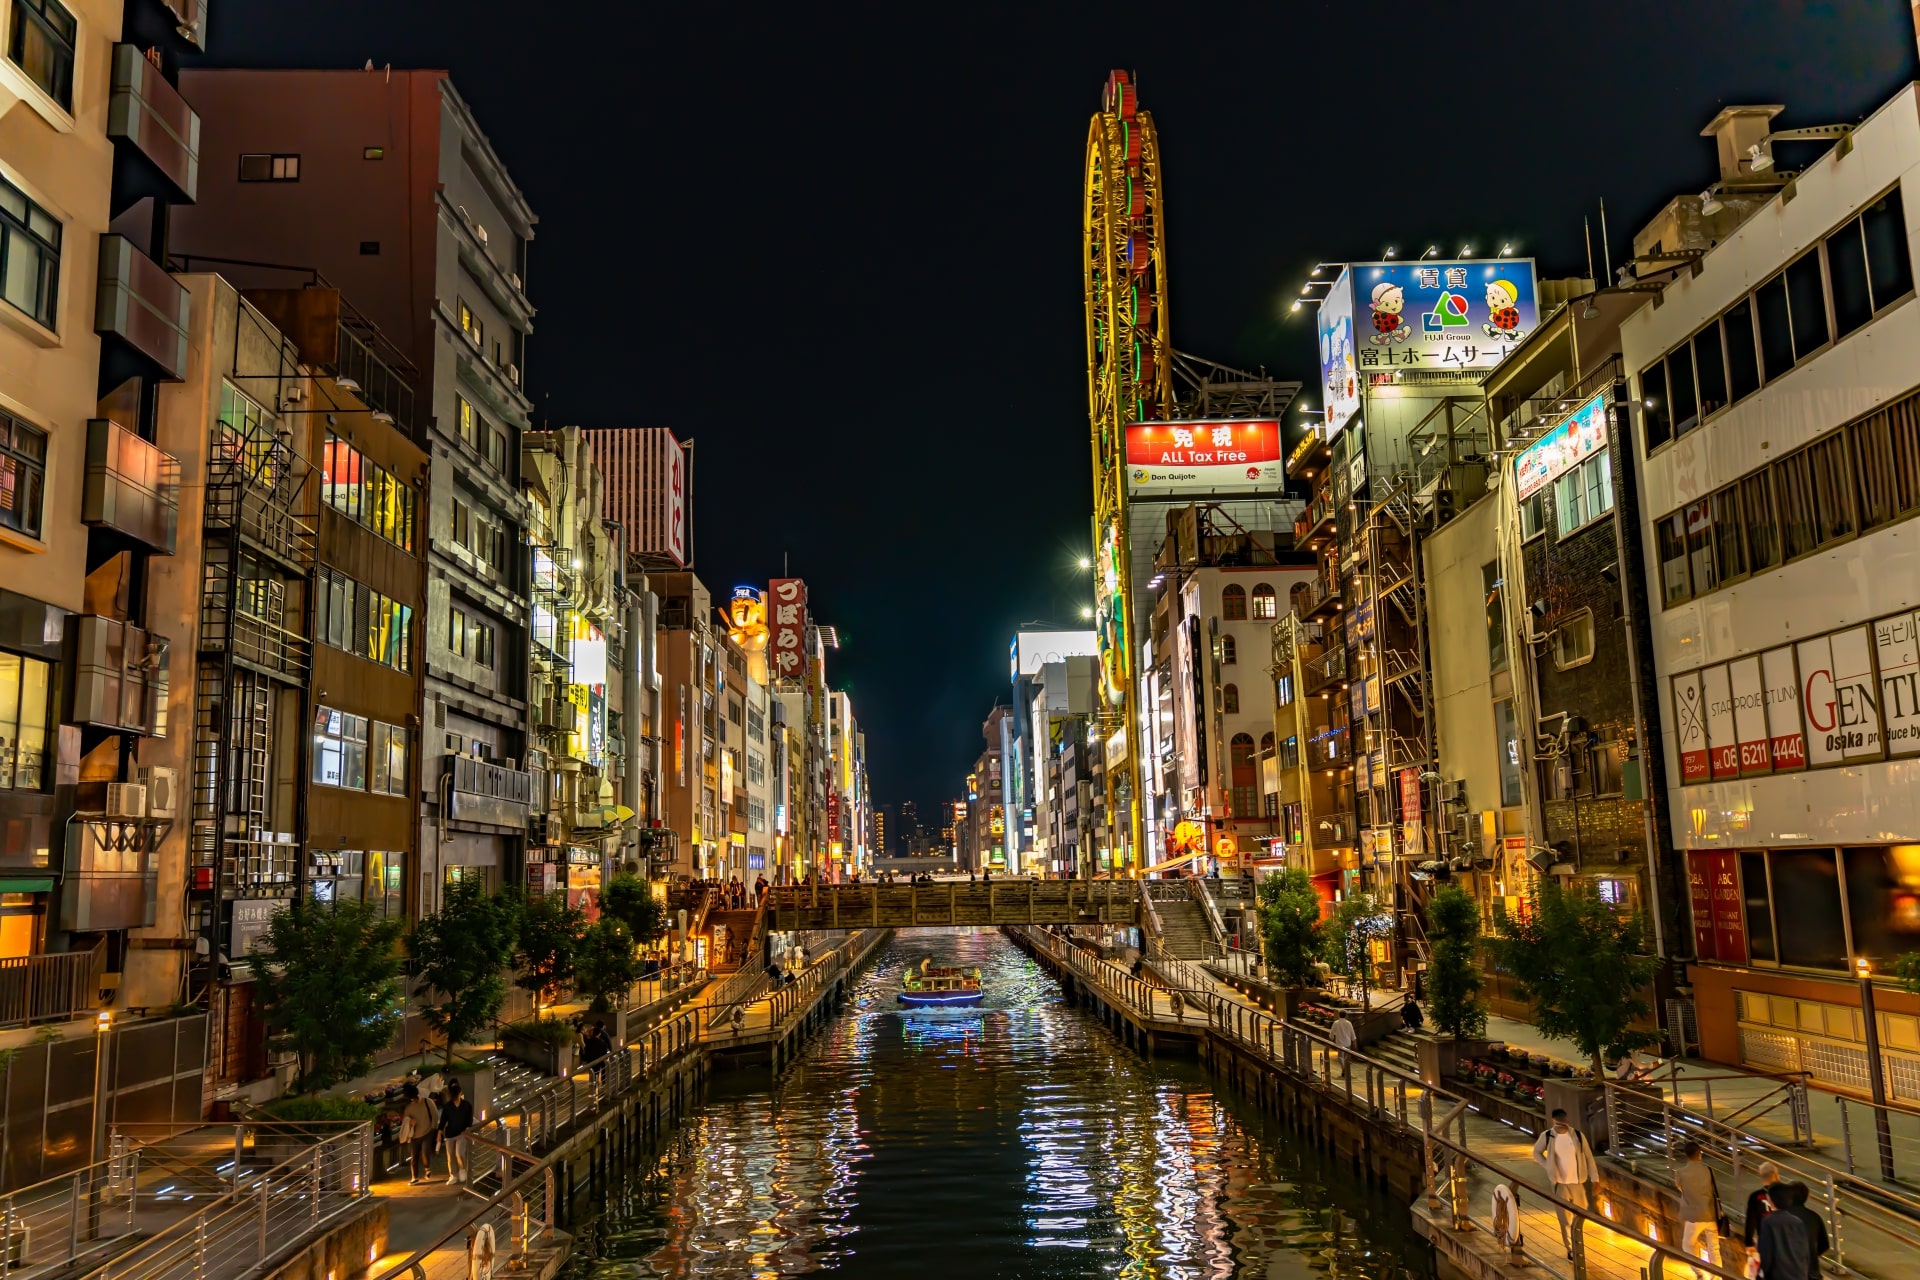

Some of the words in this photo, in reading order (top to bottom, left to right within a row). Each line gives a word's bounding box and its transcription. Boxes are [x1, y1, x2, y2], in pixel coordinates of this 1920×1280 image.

[1419, 267, 1468, 289] 賃貸
[1424, 334, 1444, 342] FUJI
[1446, 333, 1471, 341] Group
[1173, 426, 1233, 449] 免税
[1161, 451, 1184, 463] ALL
[1189, 450, 1212, 462] Tax
[1217, 450, 1247, 462] Free
[1826, 731, 1863, 751] Osaka
[1723, 749, 1737, 768] 06
[1742, 743, 1767, 766] 6211
[1773, 736, 1804, 760] 4440
[1717, 873, 1733, 885] ABC
